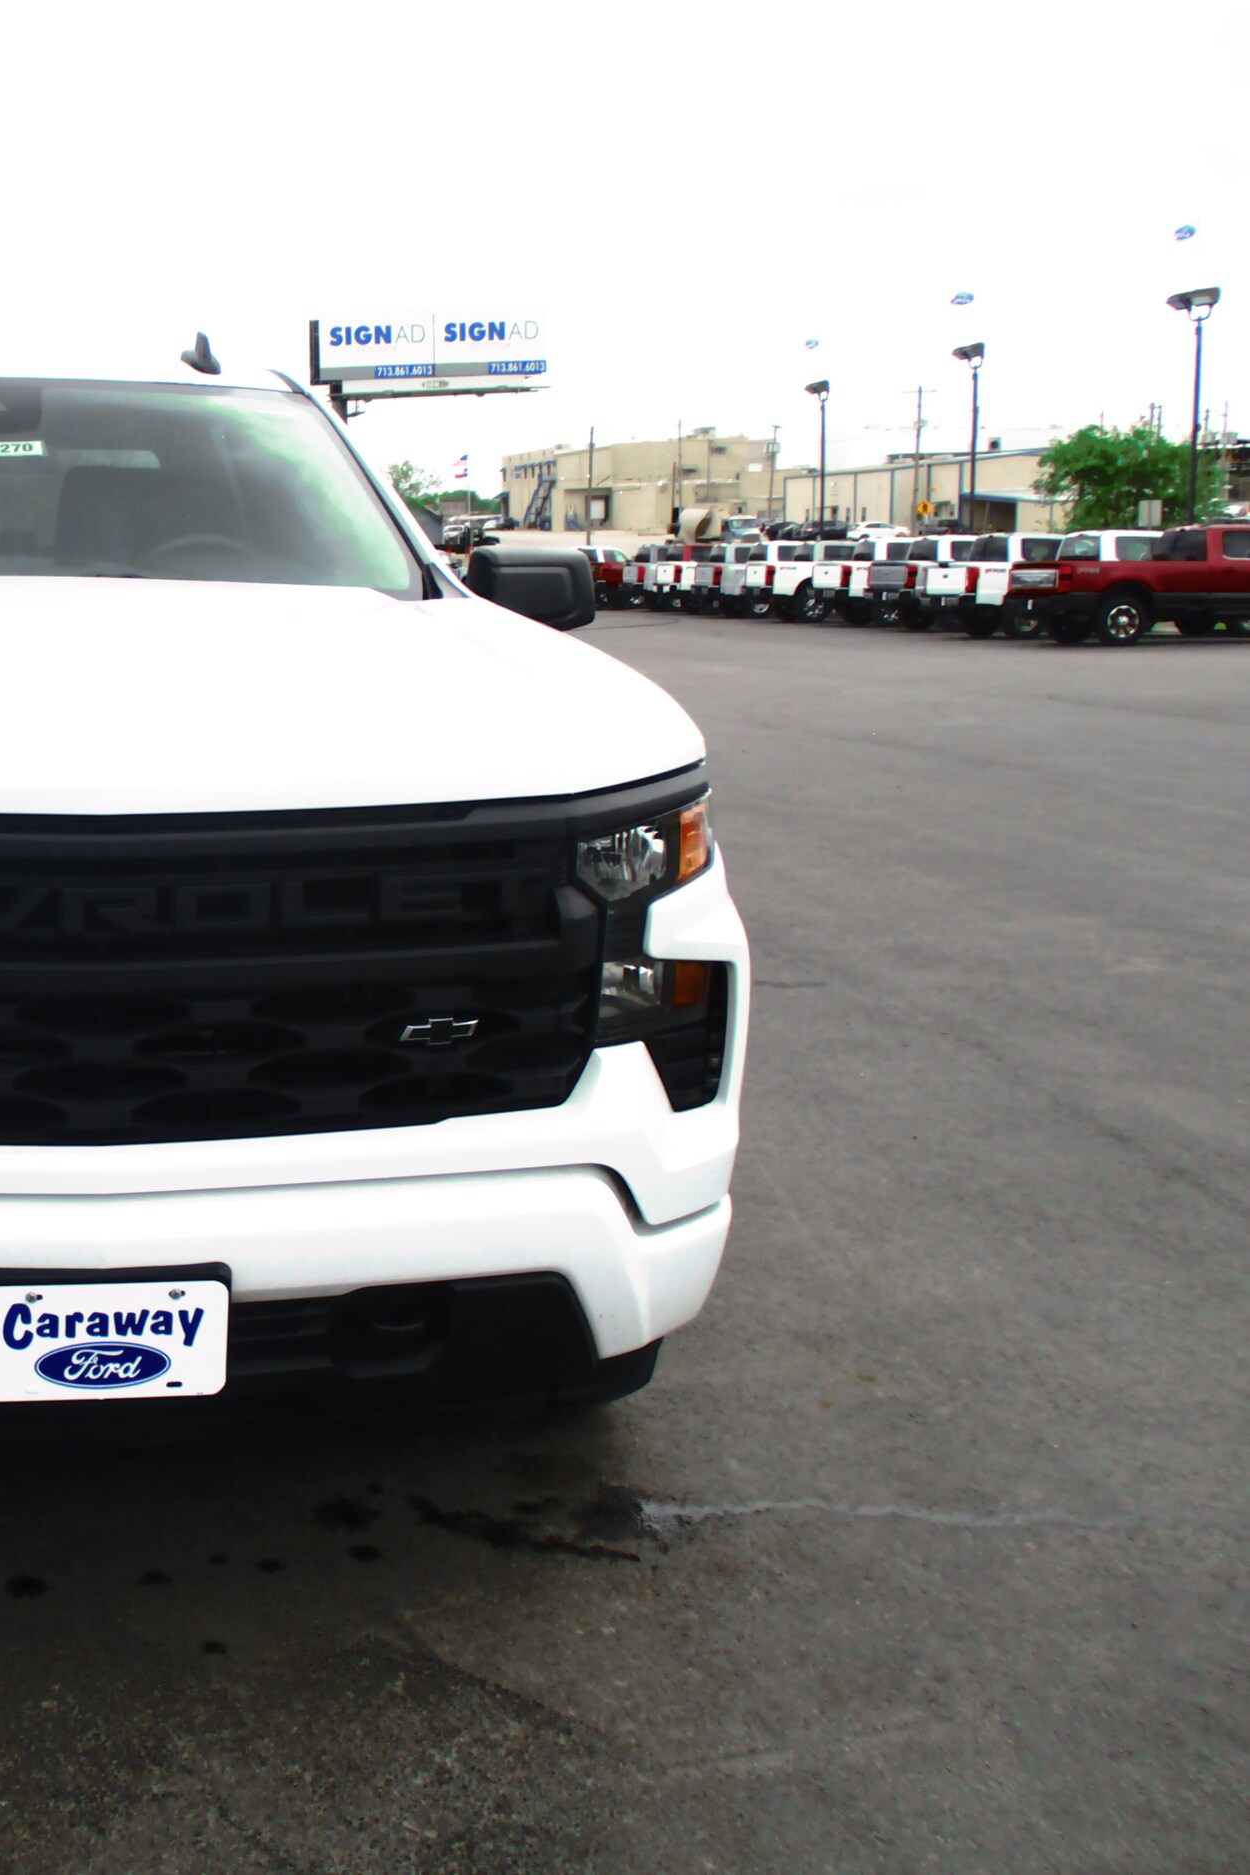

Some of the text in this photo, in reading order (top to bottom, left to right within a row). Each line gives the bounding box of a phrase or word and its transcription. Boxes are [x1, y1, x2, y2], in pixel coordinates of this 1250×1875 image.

[377, 365, 433, 377] 713.861.6013
[490, 361, 546, 374] 713.861.6013
[2, 1303, 204, 1350] Caraway
[63, 1349, 143, 1381] Ford
